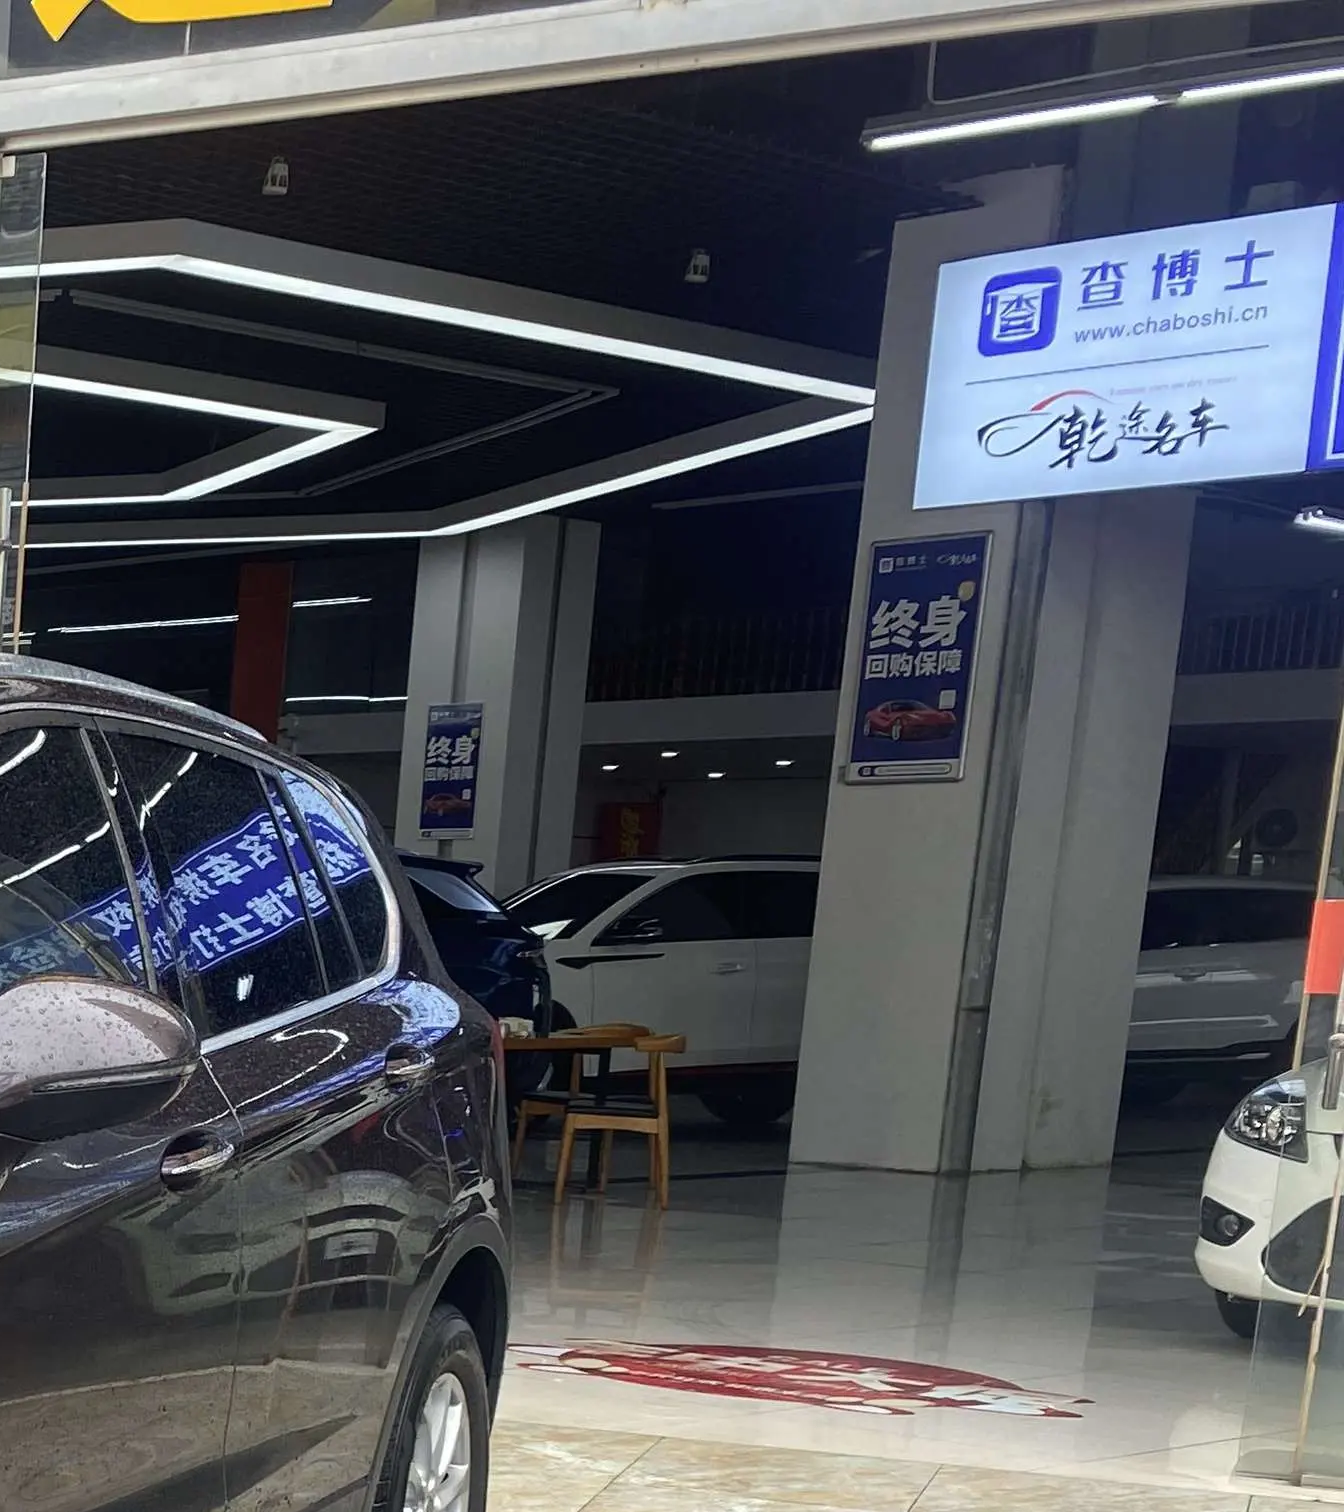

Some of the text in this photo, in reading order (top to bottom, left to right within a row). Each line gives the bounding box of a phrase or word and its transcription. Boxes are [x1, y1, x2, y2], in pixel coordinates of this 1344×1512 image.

[1077, 240, 1275, 312] 查博士
[1074, 305, 1269, 344] www.chaboshi.cn
[869, 595, 968, 650] 终身
[864, 649, 963, 680] 回购保障
[425, 735, 476, 765] 终身
